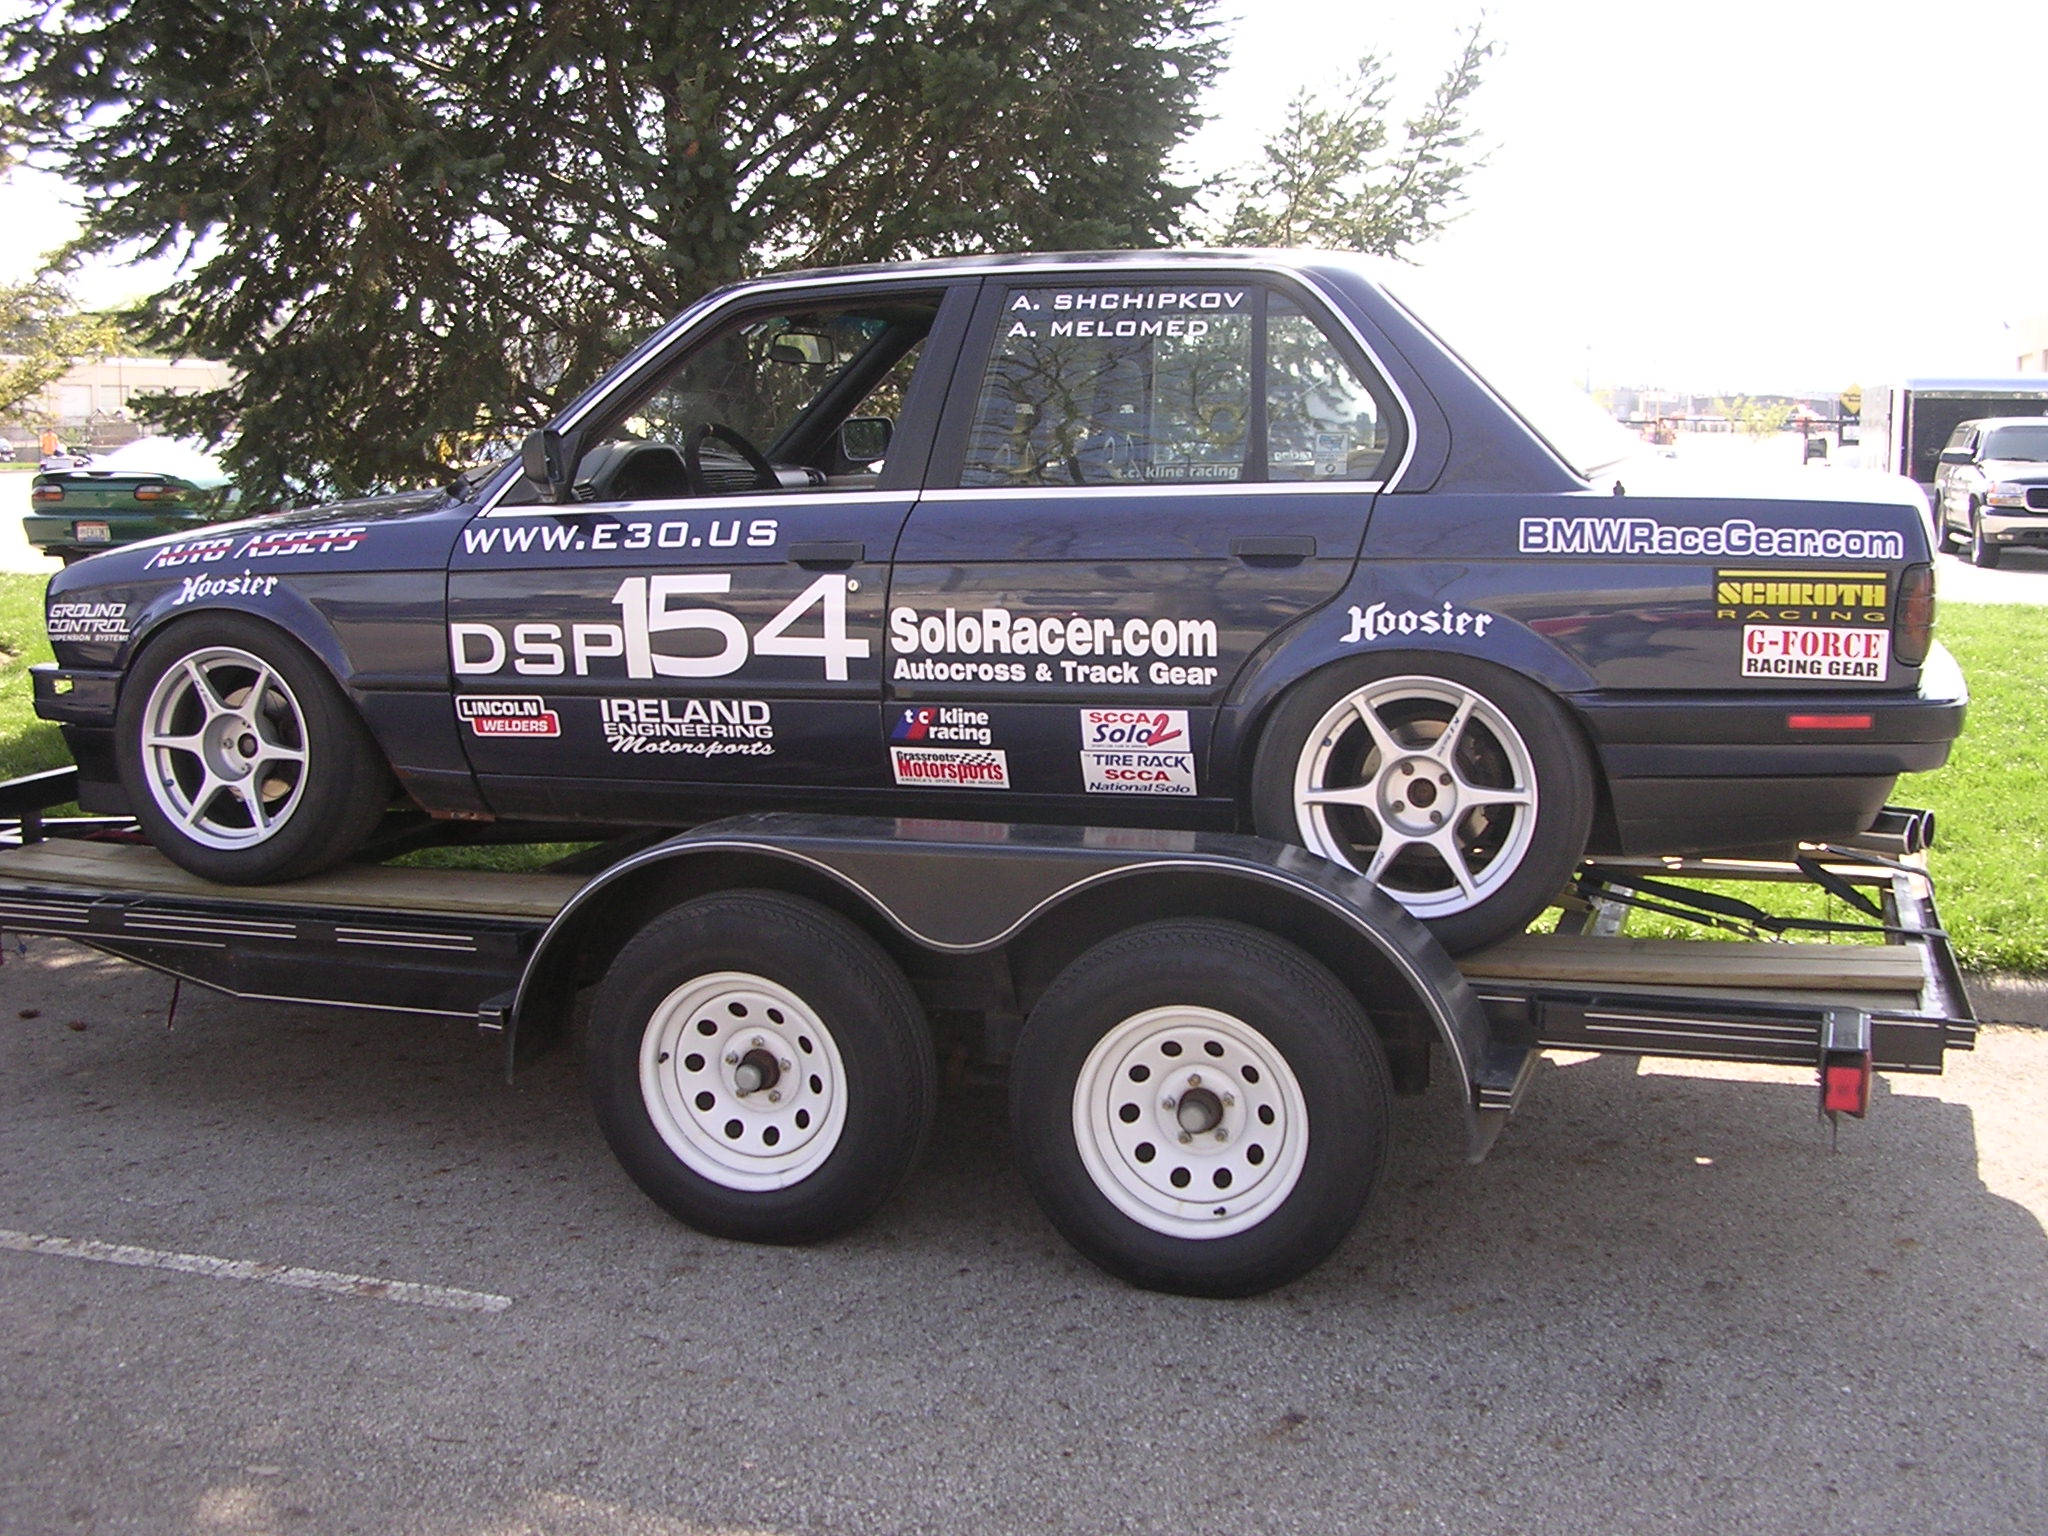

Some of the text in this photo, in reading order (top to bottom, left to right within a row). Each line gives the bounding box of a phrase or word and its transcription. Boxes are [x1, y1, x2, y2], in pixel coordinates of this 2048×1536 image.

[1011, 292, 1243, 311] A. SHCHIPKOV
[1007, 320, 1208, 338] A. MELOMED
[1145, 466, 1184, 478] kline
[1189, 465, 1240, 479] racing
[464, 520, 778, 554] WWW.E30.US
[1519, 518, 1904, 559] BMWRaceGear.com
[144, 527, 368, 570] AUTO ASSETS
[173, 569, 279, 606] Hoosier
[1718, 582, 1887, 608] SCHROTH
[50, 603, 127, 618] GROUND
[1717, 610, 1886, 621] RACING
[48, 619, 131, 633] CONTROL
[611, 573, 870, 681] 154
[890, 607, 1218, 657] SoloRacer.com
[1339, 601, 1493, 643] Hoosier
[1747, 629, 1881, 659] G-FORCE
[893, 658, 1217, 685] Autocross & Track Gear
[1747, 658, 1878, 676] RACING GEAR
[462, 701, 538, 716] LINCOLN
[601, 699, 770, 724] IRELAND
[940, 708, 989, 725] kline
[1089, 712, 1151, 724] SCCA
[482, 719, 548, 733] WELDERS
[603, 723, 774, 739] ENGINEERING
[929, 725, 991, 745] racing
[1092, 713, 1183, 747] Solo 2
[607, 735, 775, 758] Motorsports
[896, 751, 956, 762] Grassroots
[897, 760, 1004, 784] Motorsports
[1093, 754, 1191, 774] TIRE RACK
[1105, 769, 1171, 782] SCCA
[1089, 782, 1190, 793] National Solo
